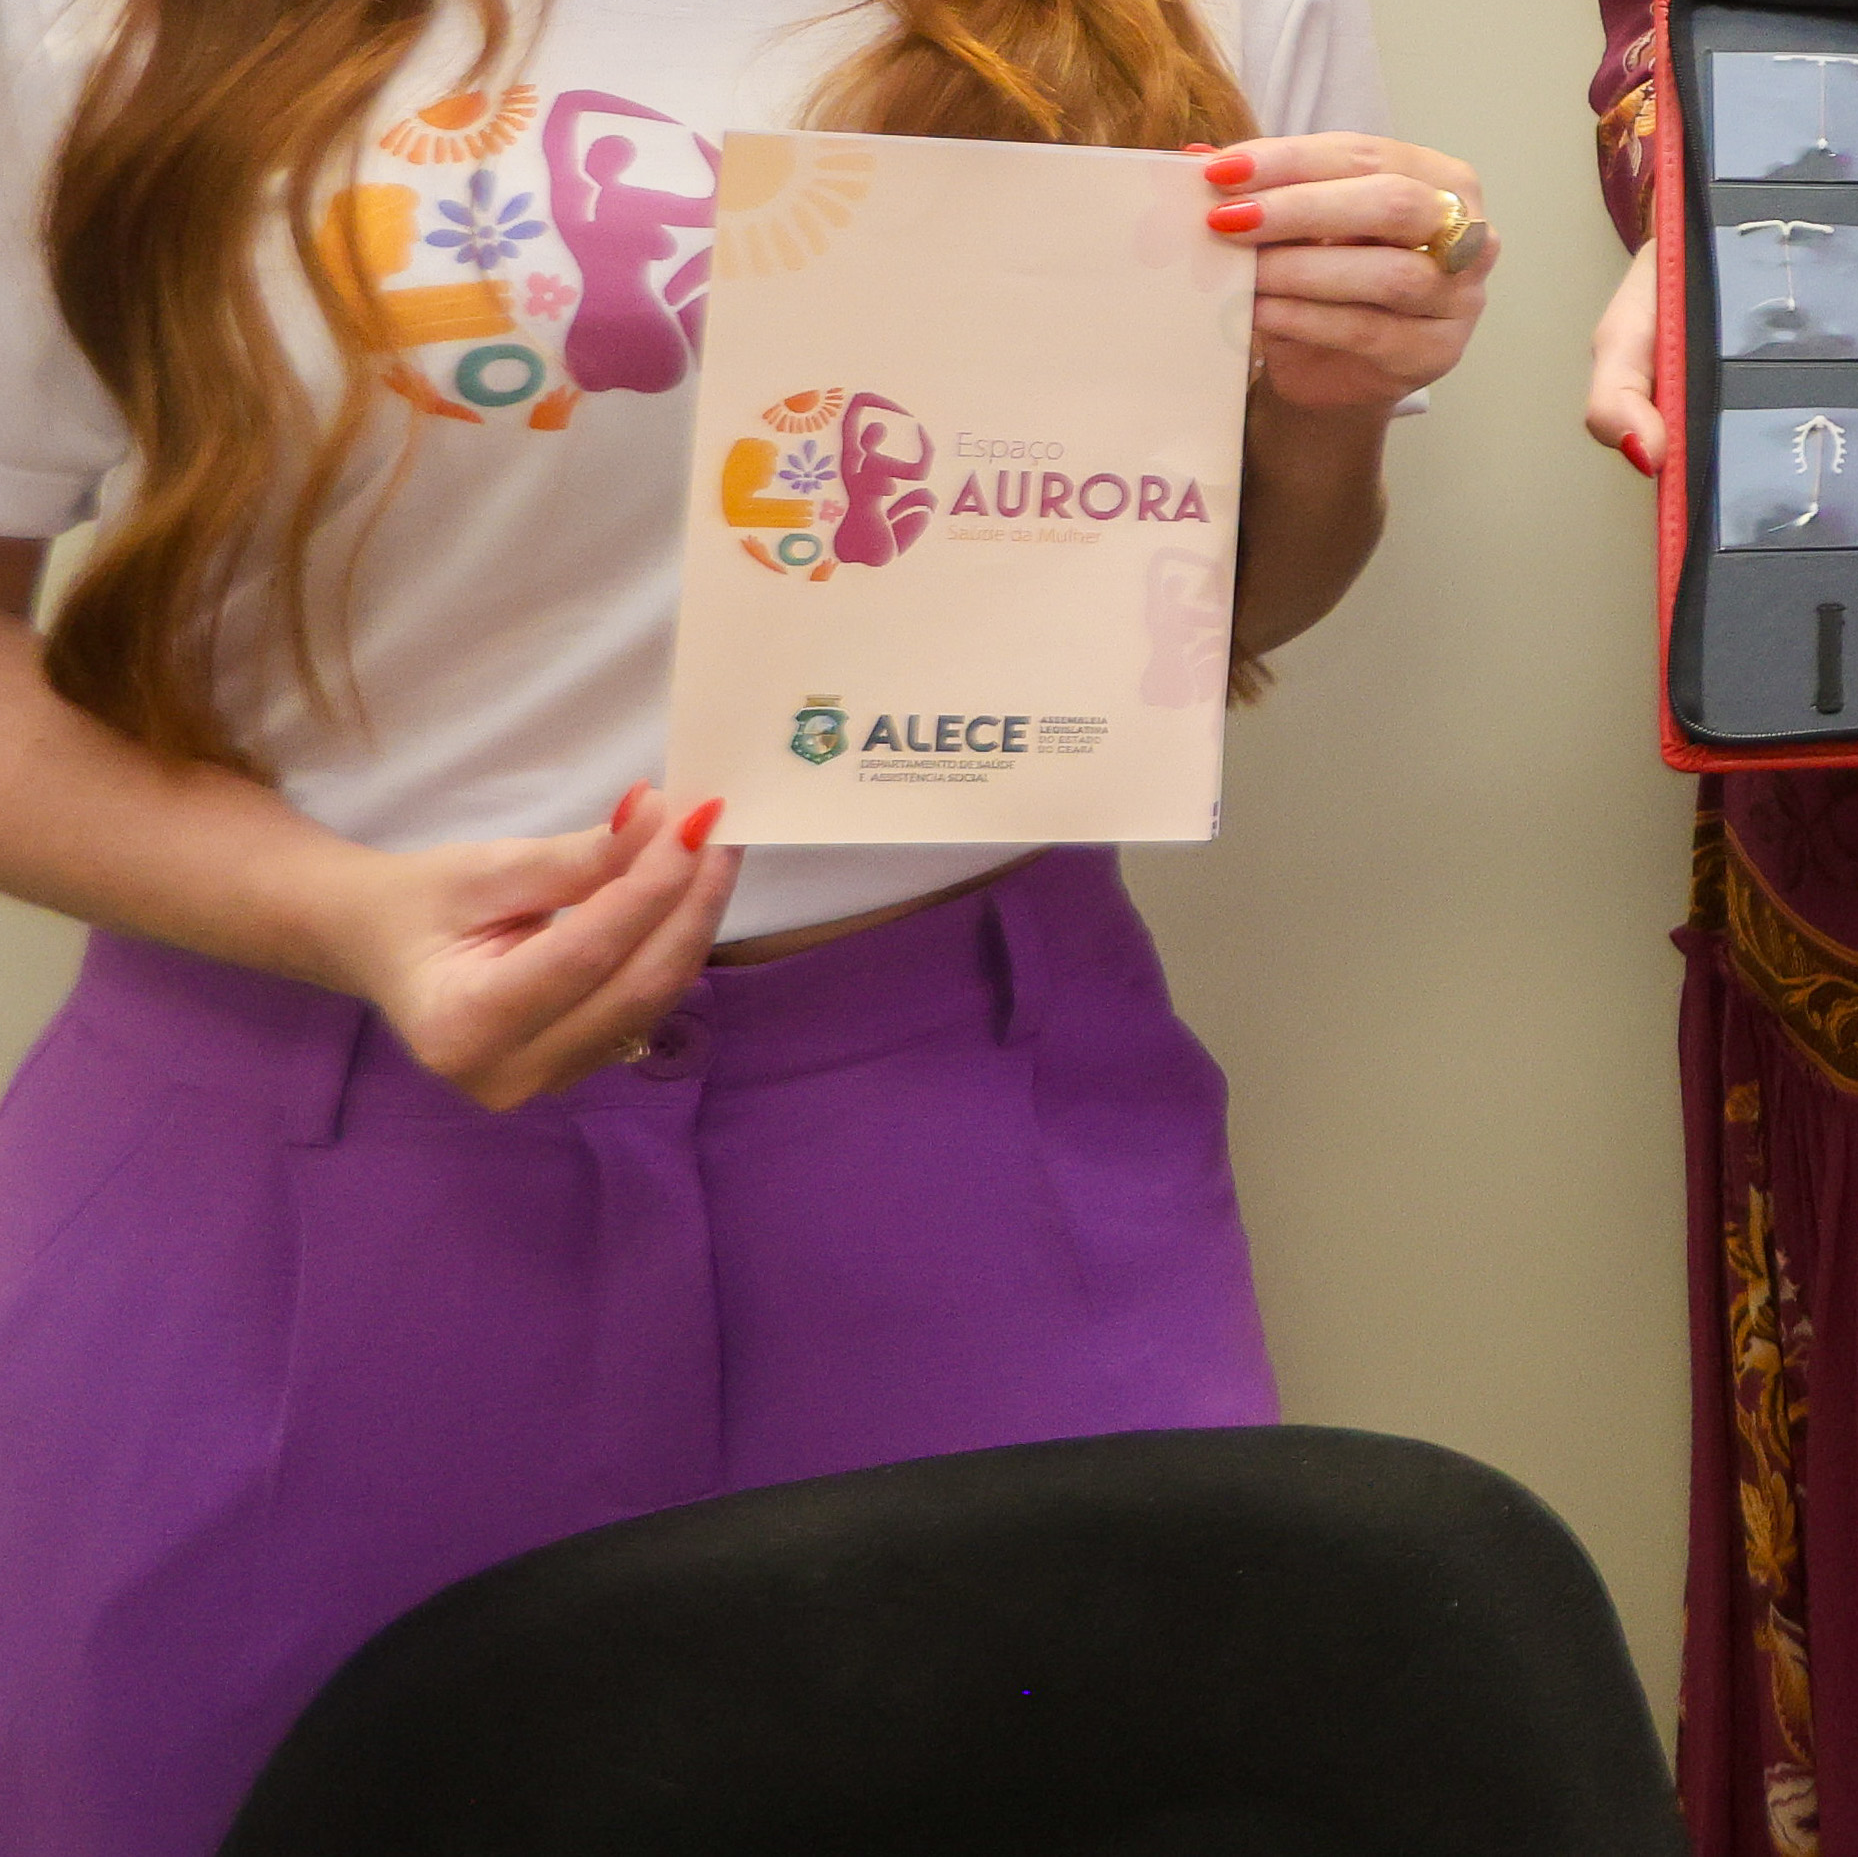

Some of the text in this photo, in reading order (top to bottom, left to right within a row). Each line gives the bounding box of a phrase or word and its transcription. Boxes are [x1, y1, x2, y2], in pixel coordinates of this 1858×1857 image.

[956, 432, 1064, 465] Espaço
[949, 470, 1211, 523] AURORA
[948, 525, 1102, 543] Saúde da Mulher
[861, 714, 1033, 753] ALECE
[1058, 736, 1100, 744] ESTADO
[860, 759, 957, 769] DEPARTAMENTO
